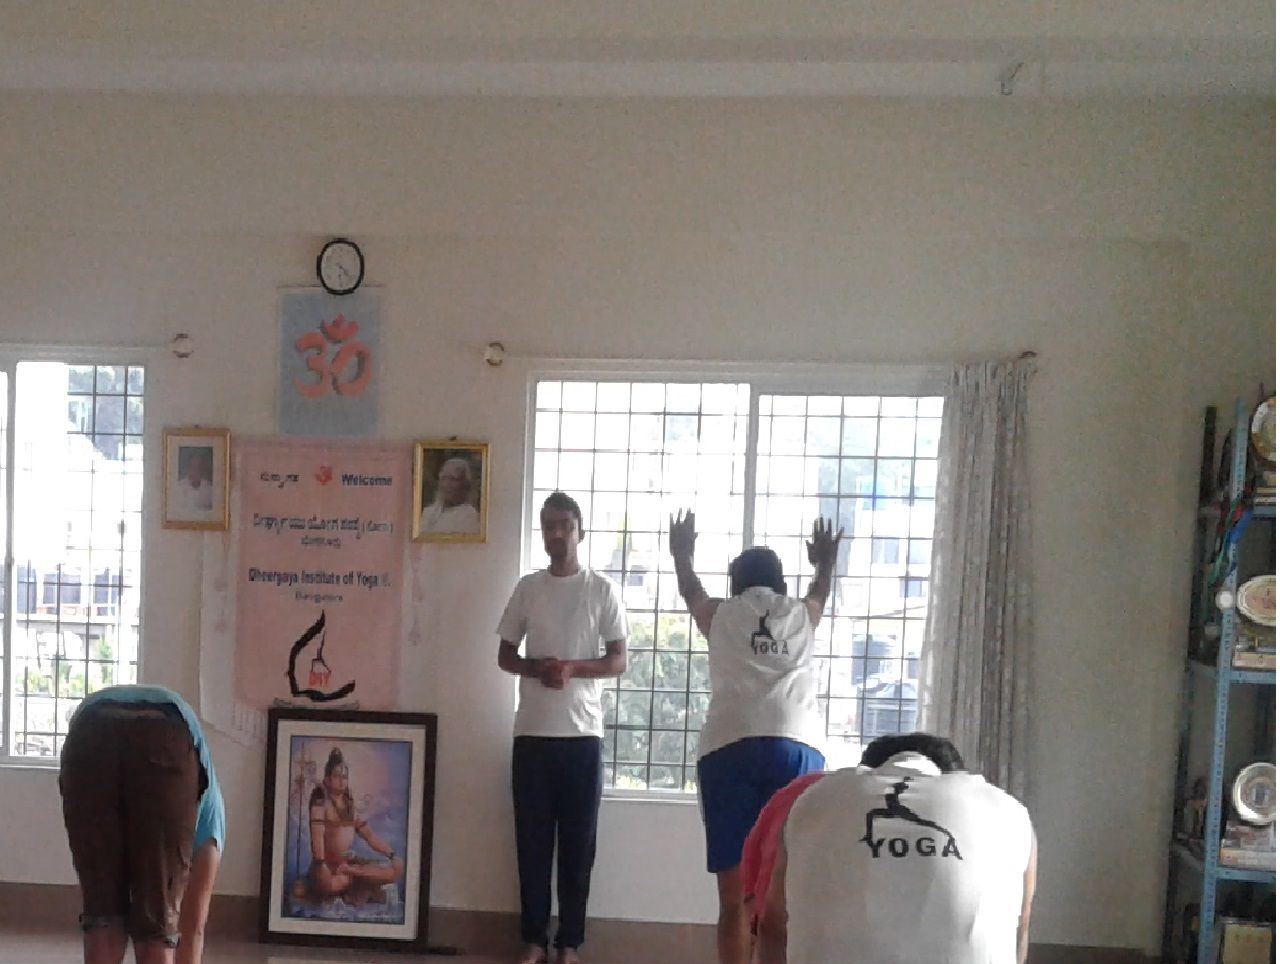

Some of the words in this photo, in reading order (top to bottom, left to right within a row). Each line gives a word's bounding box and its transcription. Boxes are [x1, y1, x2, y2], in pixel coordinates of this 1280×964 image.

[341, 473, 393, 486] Welcome
[301, 570, 341, 585] Institute
[342, 571, 354, 585] of
[356, 572, 379, 590] Yoga
[752, 639, 790, 656] YOGA
[868, 836, 962, 860] YOGA
